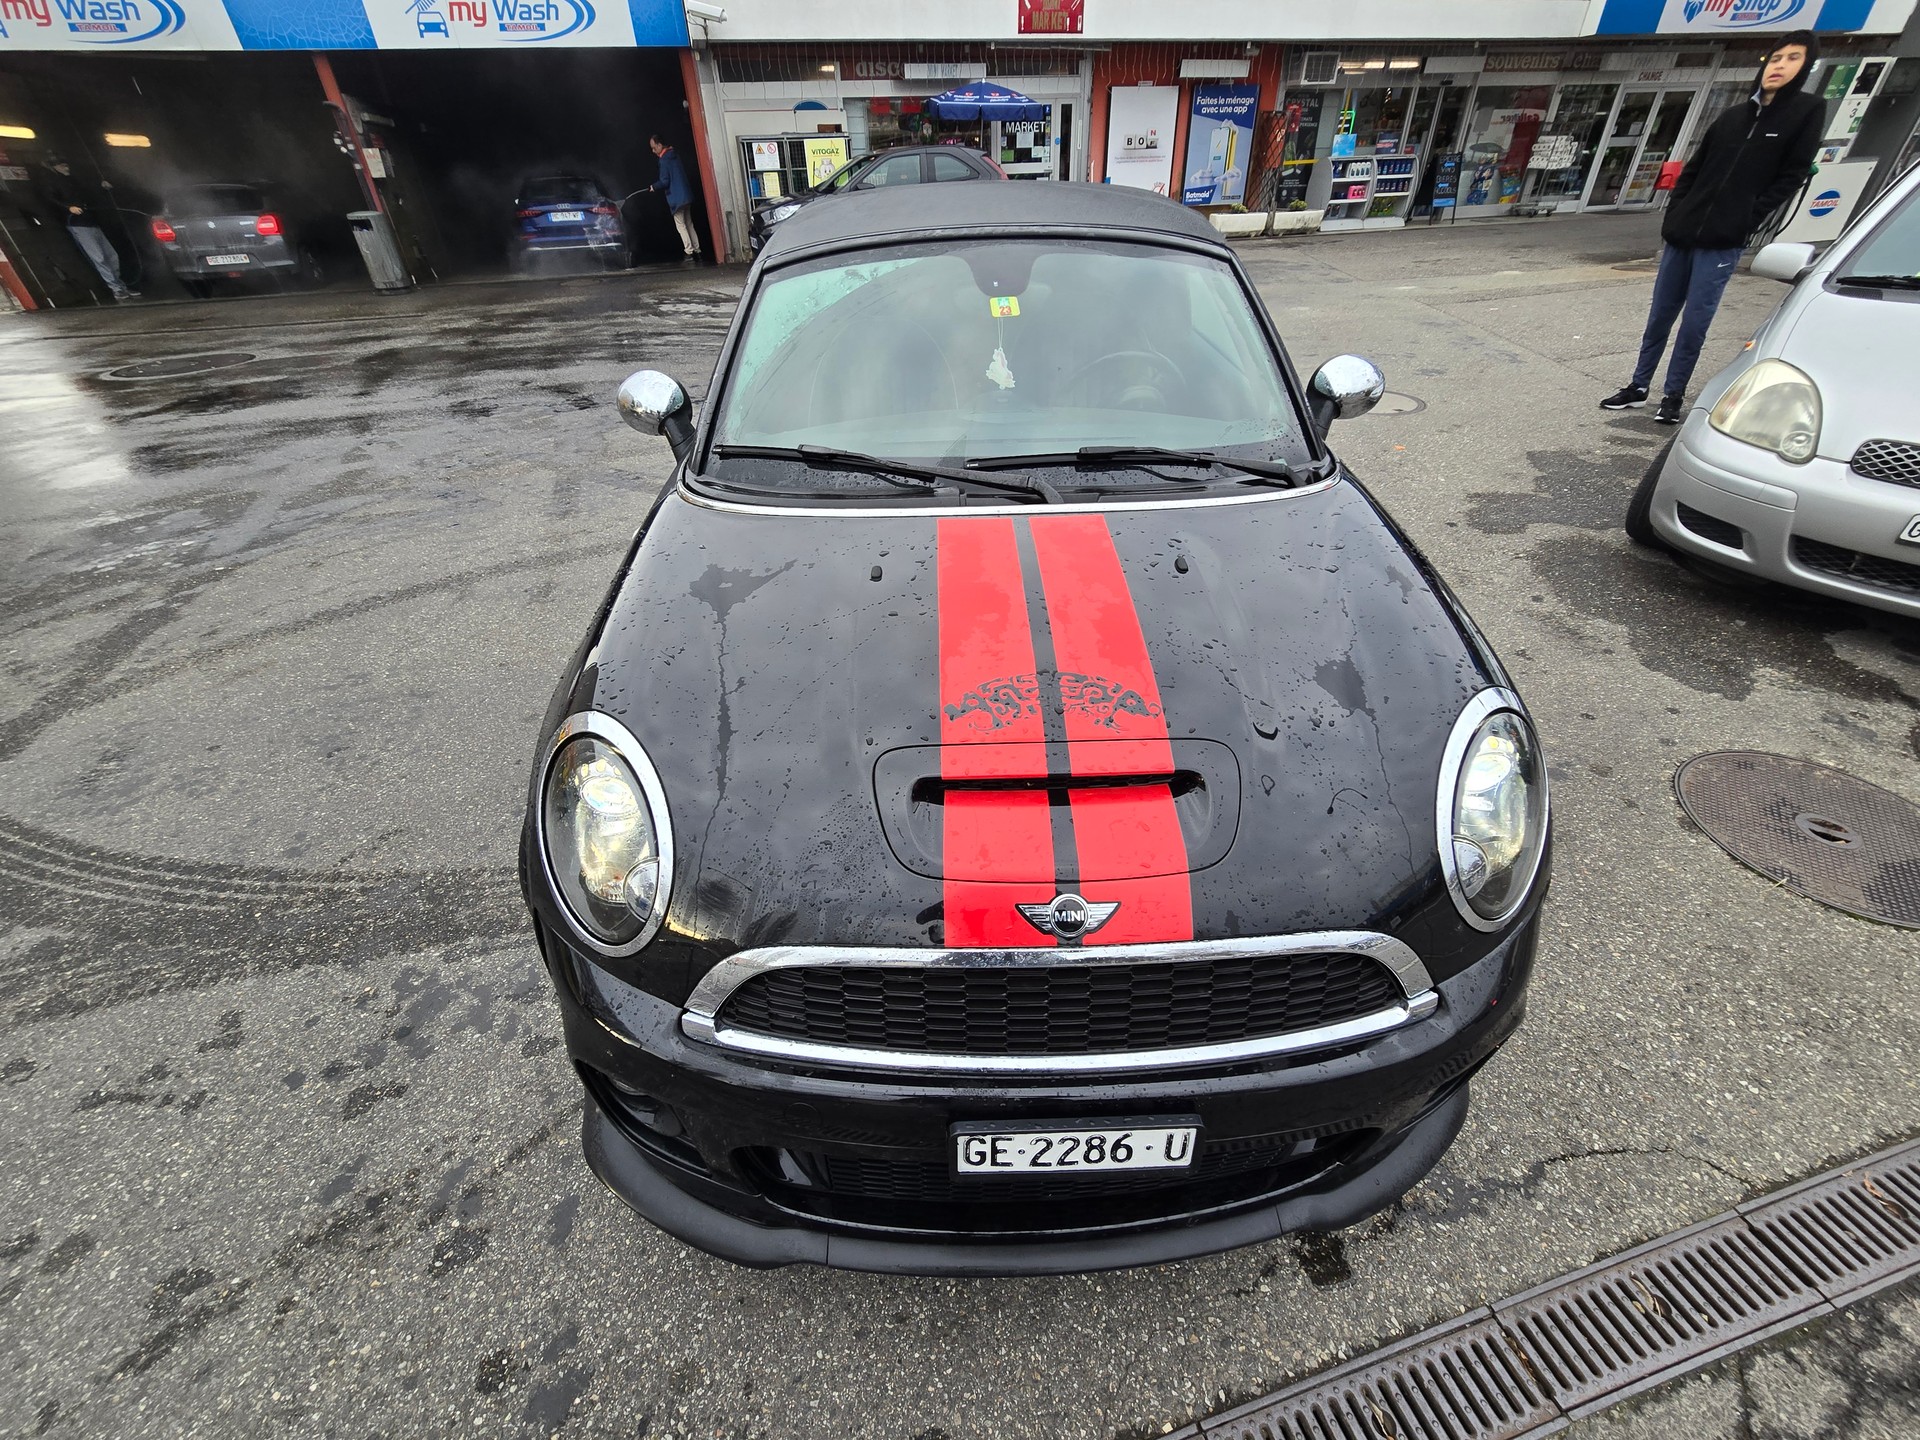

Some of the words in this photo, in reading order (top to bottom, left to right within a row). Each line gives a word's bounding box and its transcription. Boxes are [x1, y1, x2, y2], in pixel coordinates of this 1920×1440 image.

[1, 0, 52, 27] my
[55, 0, 141, 21] Wash
[449, 1, 487, 28] my
[493, 0, 559, 21] Wash
[76, 23, 121, 32] TAMOIL
[505, 23, 540, 32] TAMOIL
[1485, 53, 1561, 69] souvenirs
[855, 61, 905, 77] disc
[1638, 71, 1664, 82] CHANGE
[1196, 96, 1218, 105] Faites
[1219, 96, 1225, 104] le
[1226, 96, 1254, 107] ménage
[1233, 106, 1248, 114] app
[1005, 121, 1046, 133] MARKET
[1810, 199, 1840, 209] TAMOIL
[999, 306, 1012, 316] 23
[1054, 910, 1085, 922] MINI
